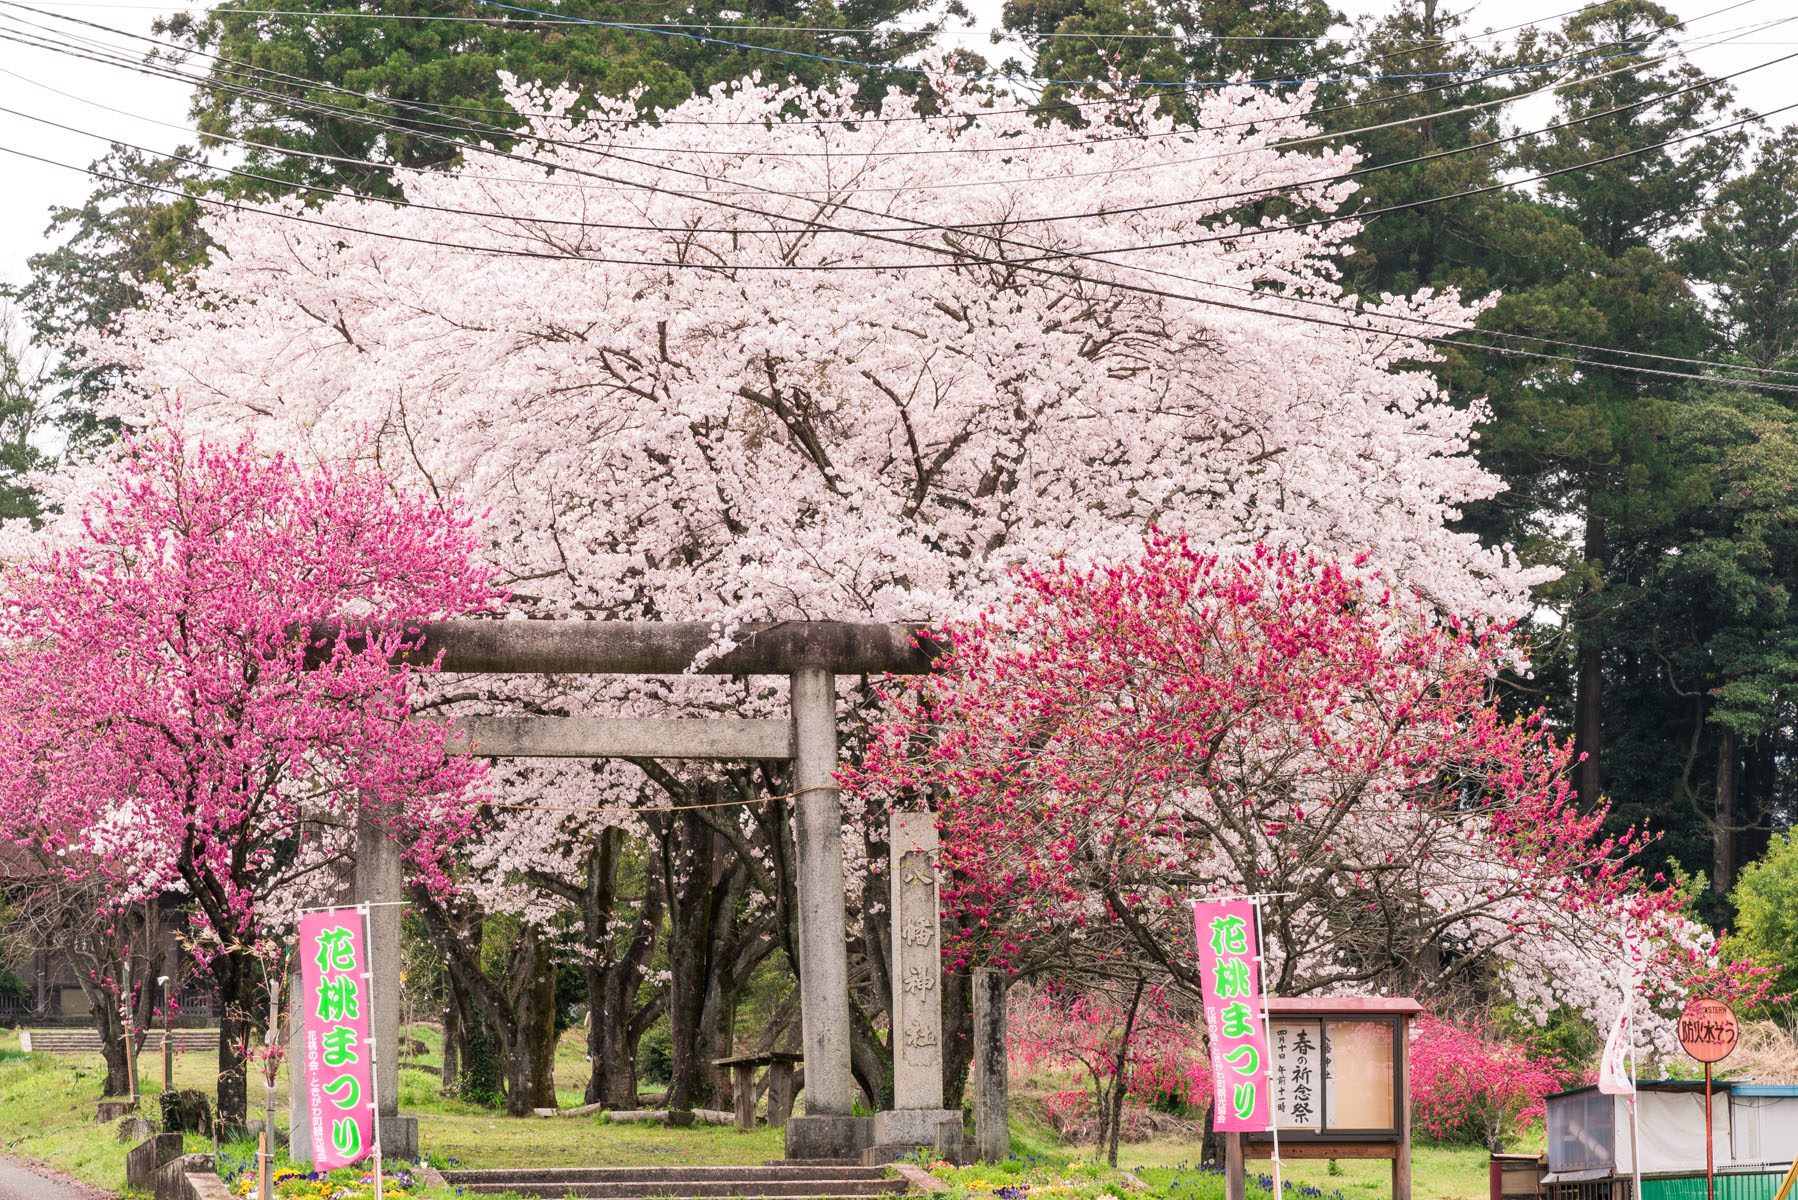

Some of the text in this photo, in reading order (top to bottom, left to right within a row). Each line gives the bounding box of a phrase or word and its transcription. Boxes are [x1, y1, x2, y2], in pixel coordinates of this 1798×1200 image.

[315, 927, 361, 1157] 花桃まつり
[902, 869, 937, 1048] 八幡神社
[1209, 915, 1260, 1119] 花桃まつり
[1681, 1020, 1735, 1044] 防火水そう
[1291, 1029, 1316, 1123] 春の祈念祭
